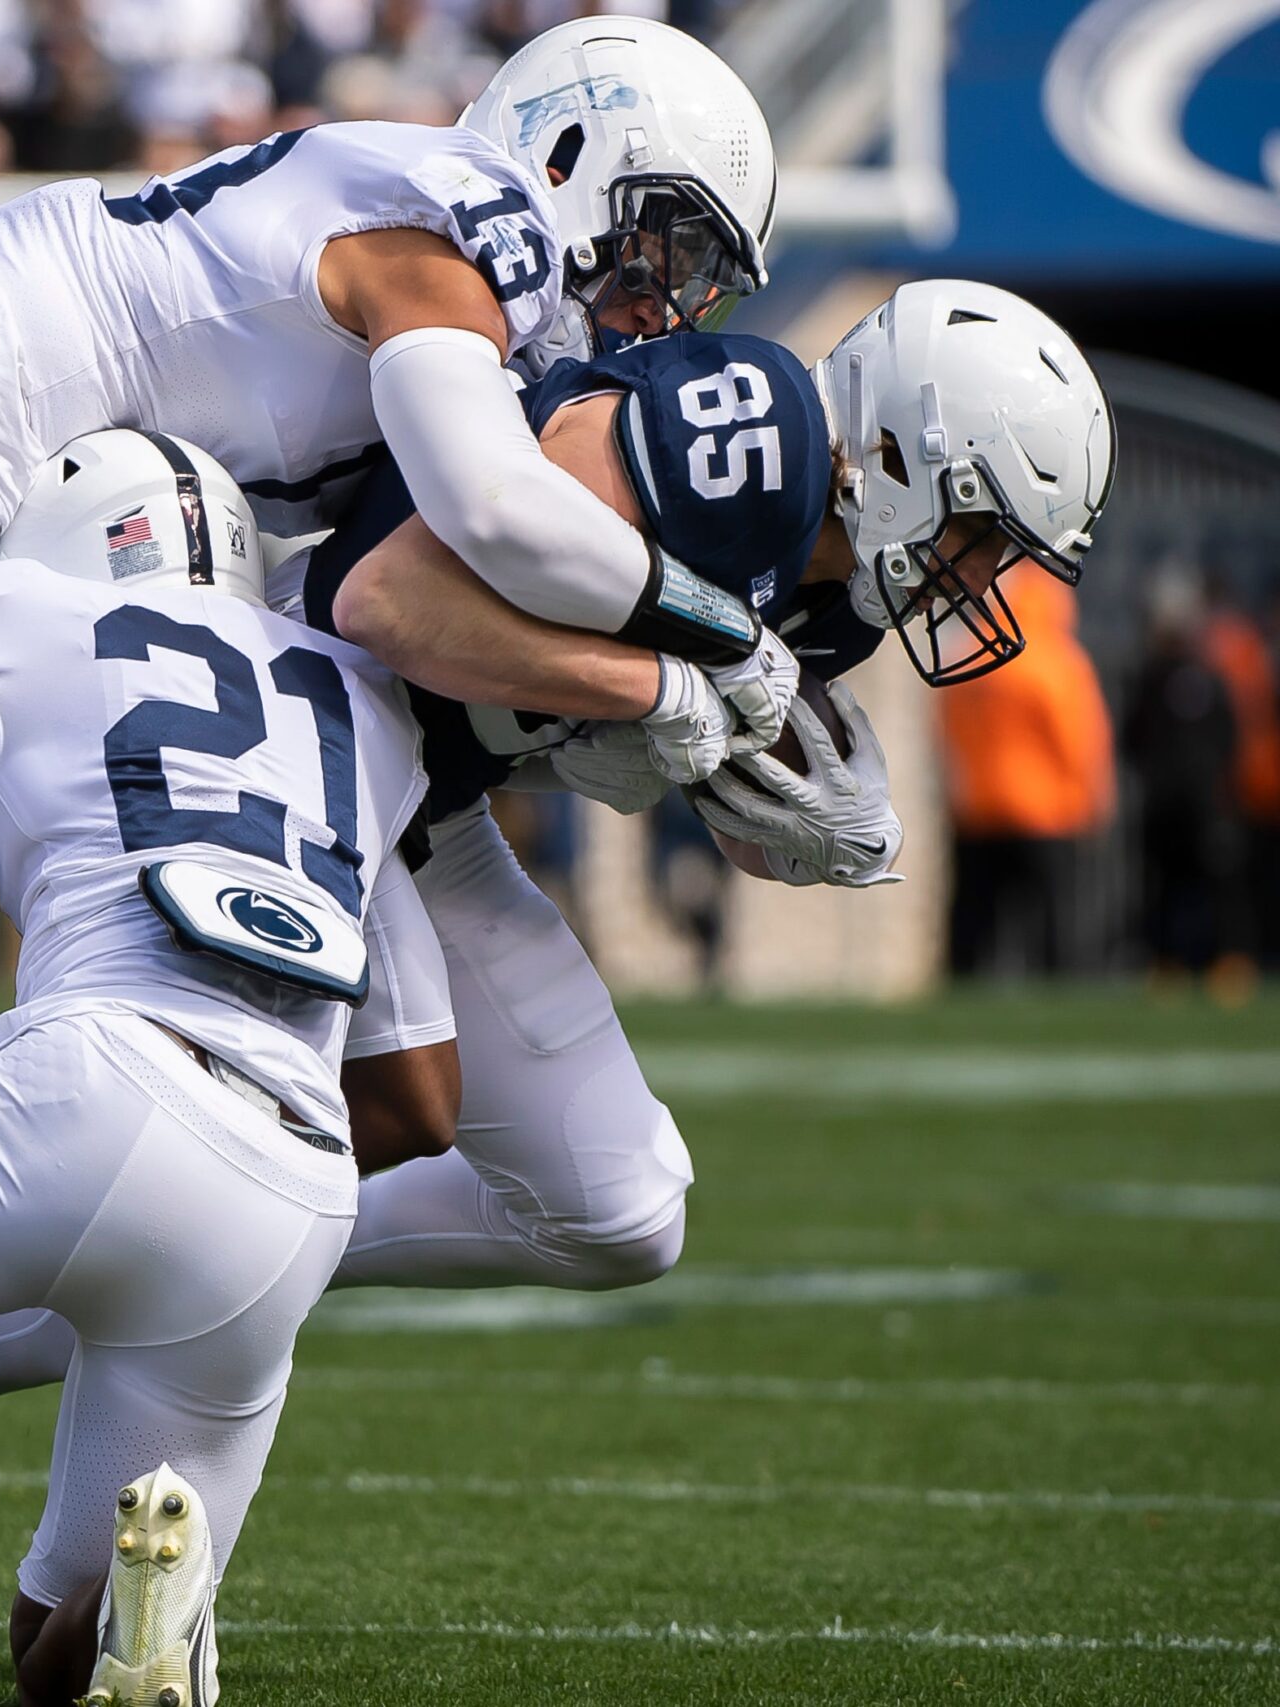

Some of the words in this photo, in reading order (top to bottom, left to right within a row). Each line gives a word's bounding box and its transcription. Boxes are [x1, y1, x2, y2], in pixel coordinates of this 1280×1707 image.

[449, 186, 551, 302] 13
[677, 362, 782, 500] 85
[94, 604, 365, 919] 21
